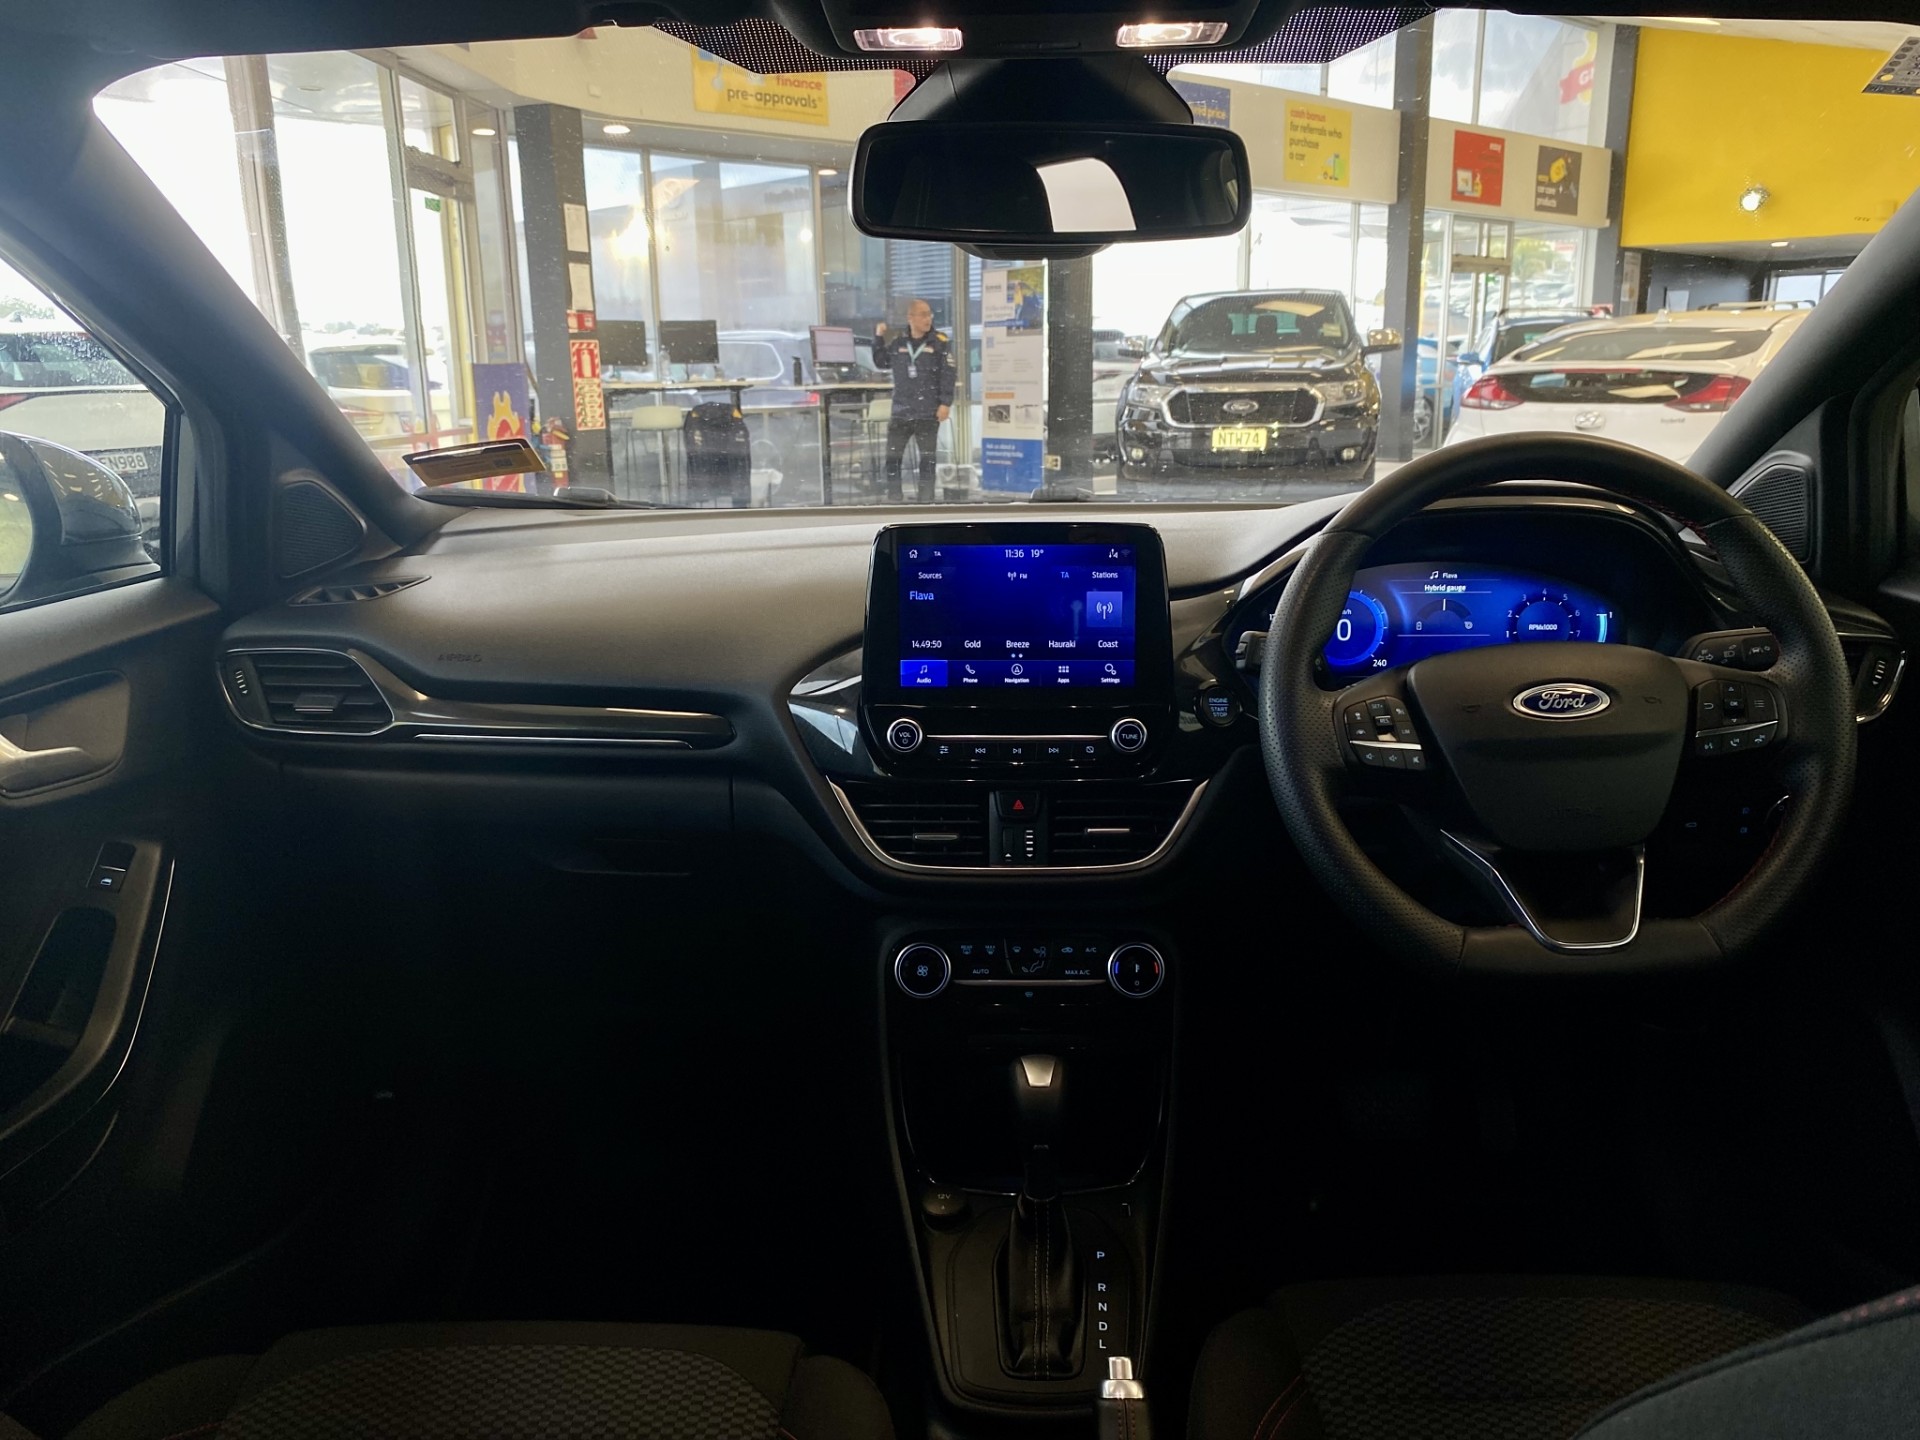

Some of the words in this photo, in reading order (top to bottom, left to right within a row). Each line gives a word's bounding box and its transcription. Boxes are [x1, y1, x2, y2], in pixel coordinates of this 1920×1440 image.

[776, 75, 822, 91] finance
[1290, 108, 1305, 118] cash
[1307, 110, 1326, 122] bonus
[1289, 121, 1299, 132] for
[1300, 122, 1327, 136] referrals
[1328, 127, 1342, 139] who
[1289, 138, 1319, 150] purchase
[1295, 153, 1306, 161] car
[1218, 431, 1259, 445] NTW74
[1005, 549, 1025, 559] 11:36
[1030, 549, 1044, 559] 19°
[918, 571, 942, 580] Sources
[1061, 571, 1070, 579] TA
[1092, 570, 1118, 579] Stations
[1442, 571, 1458, 580] Flava
[1424, 583, 1445, 593] Hybrid
[1447, 584, 1466, 593] gauge
[1542, 588, 1548, 596] 4
[909, 590, 935, 601] Flava
[1522, 594, 1527, 602] 3
[1562, 593, 1568, 601] 5
[1507, 609, 1513, 618] 2
[1575, 609, 1580, 617] 6
[1336, 618, 1352, 642] 0
[1528, 623, 1558, 631] RPMx1000
[1576, 630, 1581, 638] 7
[964, 639, 981, 649] Gold
[1006, 639, 1030, 649] Breeze
[1048, 639, 1076, 649] Hauraki
[1097, 639, 1119, 649] Coast
[1373, 659, 1387, 667] 240
[1004, 677, 1030, 685] Navigation
[1057, 677, 1070, 685] Apps
[1101, 677, 1120, 685] Settings
[1539, 690, 1587, 710] Ford
[1097, 1251, 1105, 1259] P
[1098, 1283, 1106, 1292] R
[1098, 1302, 1108, 1312] N
[1098, 1321, 1108, 1331] D
[1098, 1339, 1107, 1349] L
